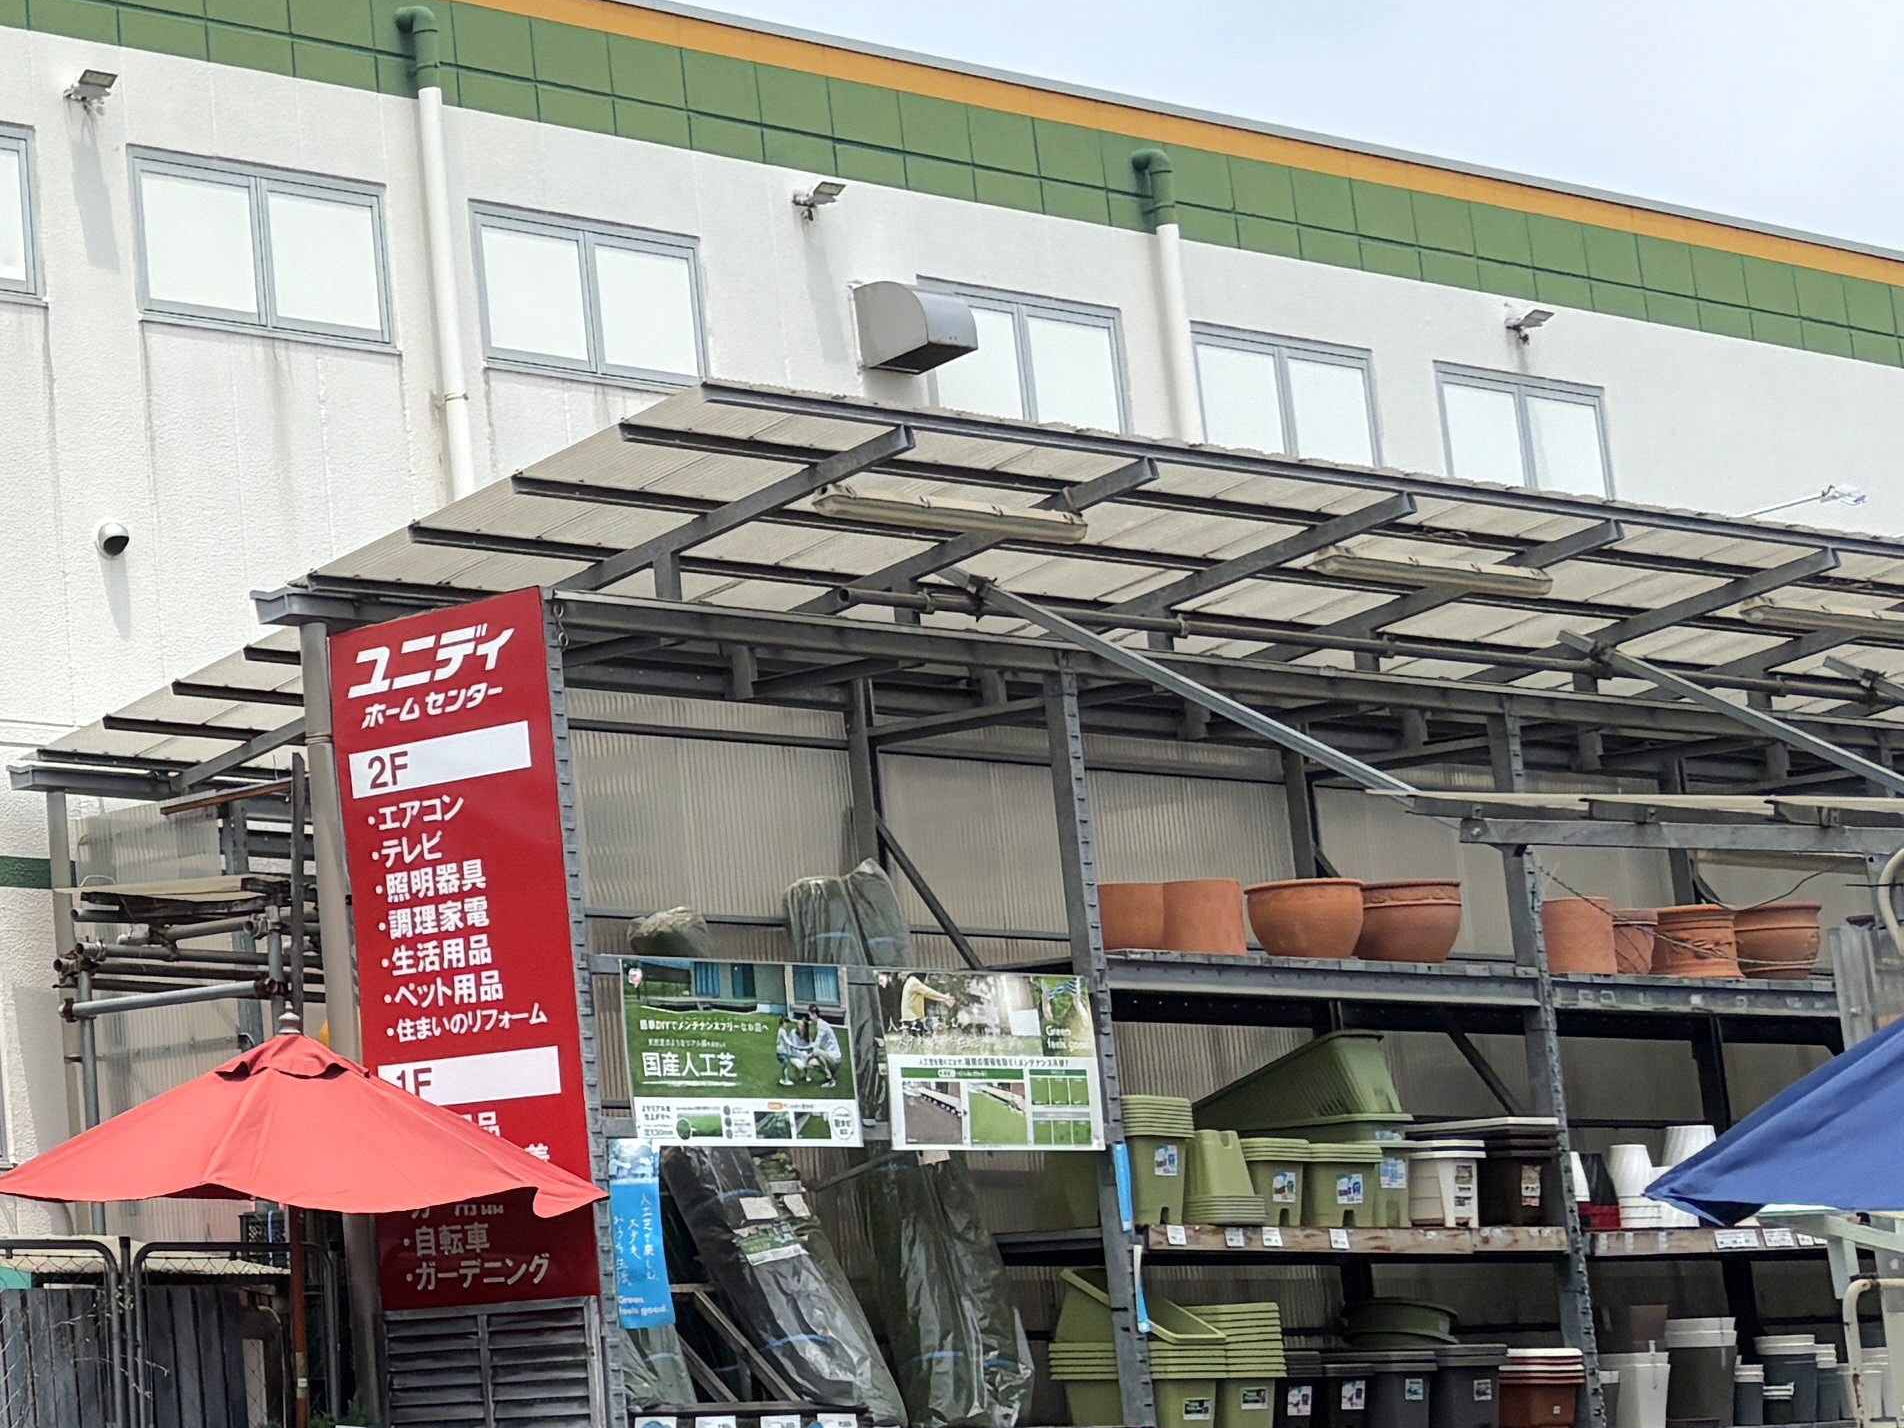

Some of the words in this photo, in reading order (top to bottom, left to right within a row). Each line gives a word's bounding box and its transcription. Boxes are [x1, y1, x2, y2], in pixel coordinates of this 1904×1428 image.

[347, 623, 516, 699] ユニディ
[360, 682, 504, 730] ホームセンター
[367, 750, 410, 791] 2F
[1045, 1024, 1072, 1037] Green
[641, 1051, 738, 1079] 国産人工芝
[618, 1294, 644, 1305] Green
